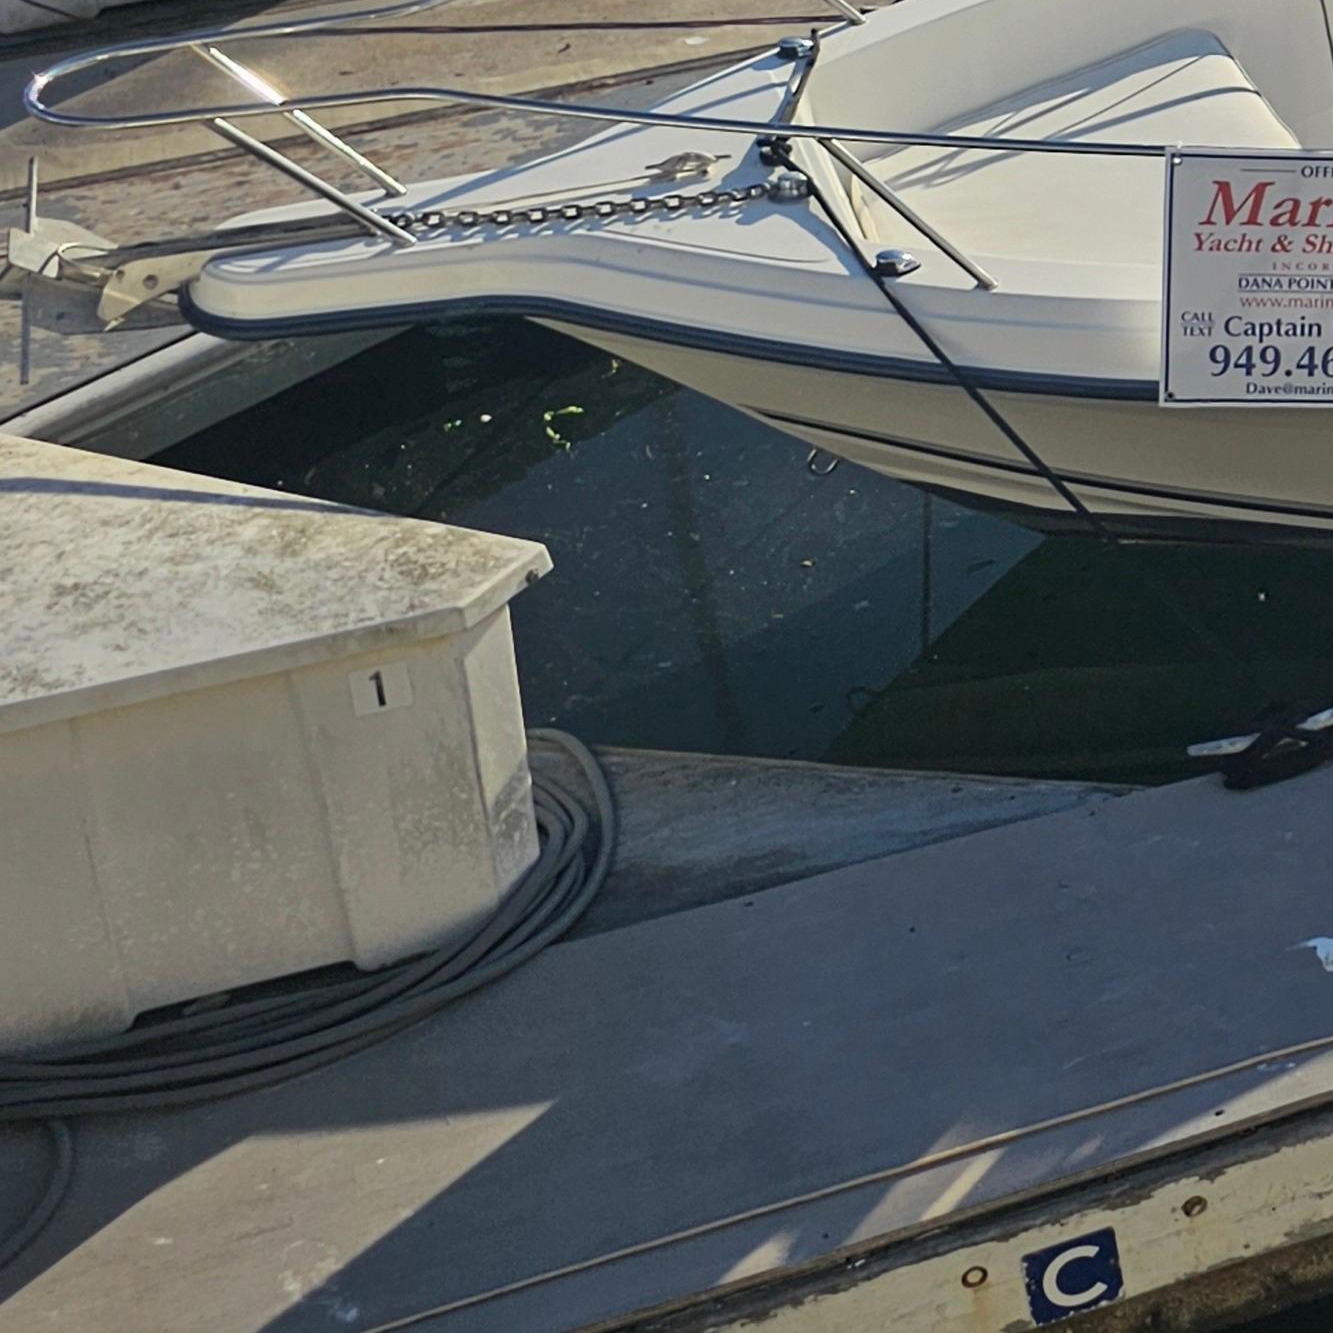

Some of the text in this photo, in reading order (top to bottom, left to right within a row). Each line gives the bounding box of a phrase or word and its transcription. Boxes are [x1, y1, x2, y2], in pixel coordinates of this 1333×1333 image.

[1194, 232, 1264, 253] Yacht
[1270, 234, 1294, 253] &
[1238, 277, 1284, 290] DANA
[1181, 311, 1214, 323] CALL
[1183, 326, 1214, 337] TEXT
[1224, 315, 1323, 344] Captain
[369, 670, 386, 707] 1
[1043, 1245, 1108, 1307] C
